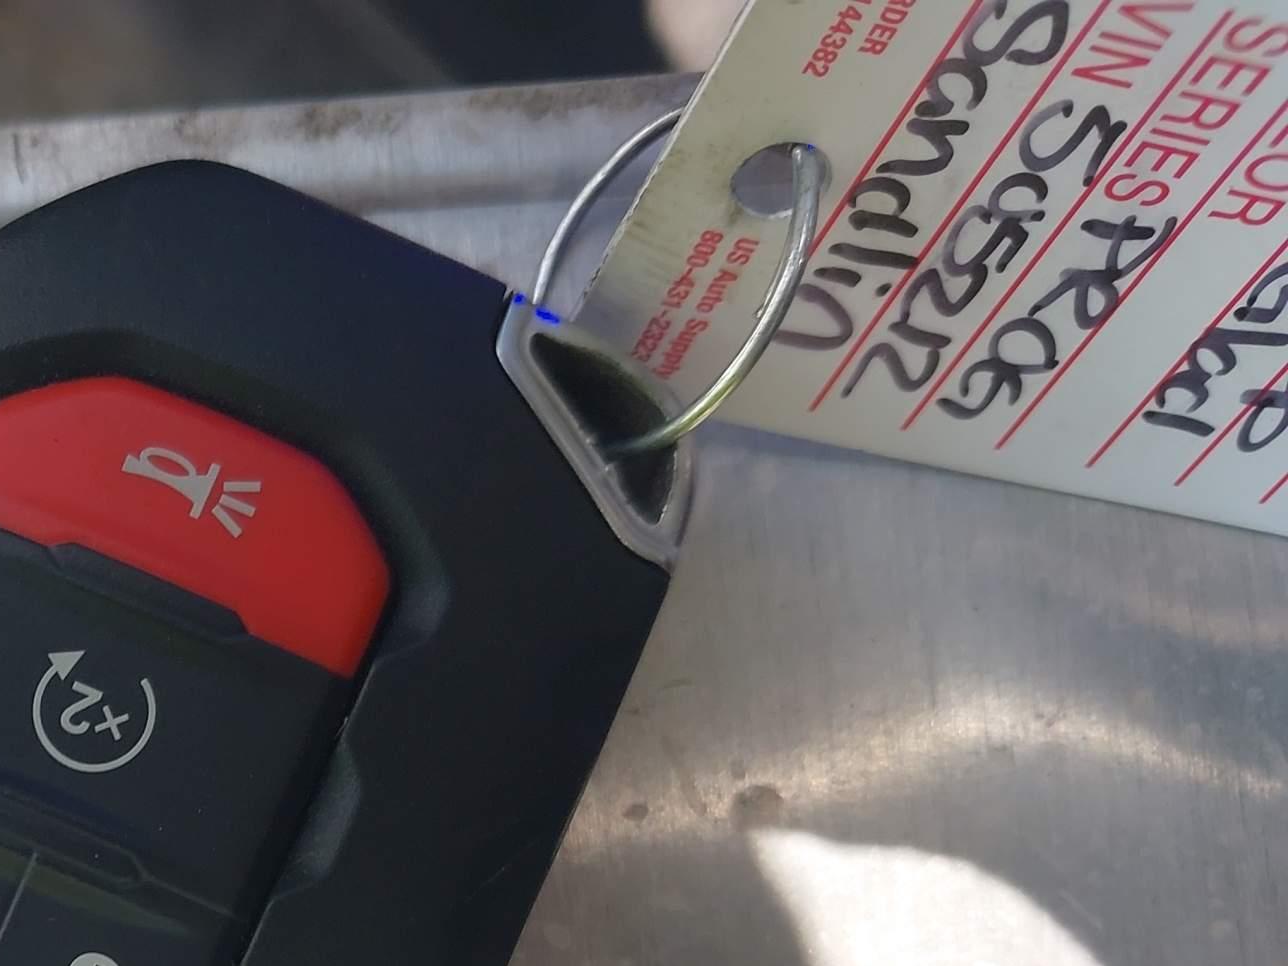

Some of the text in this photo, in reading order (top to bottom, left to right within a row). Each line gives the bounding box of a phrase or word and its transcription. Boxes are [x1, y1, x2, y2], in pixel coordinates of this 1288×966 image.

[1070, 0, 1196, 90] VIN
[1103, 15, 1288, 207] SERIES
[631, 229, 724, 362] 800-431-2323
[651, 237, 760, 380] US Auto Supply
